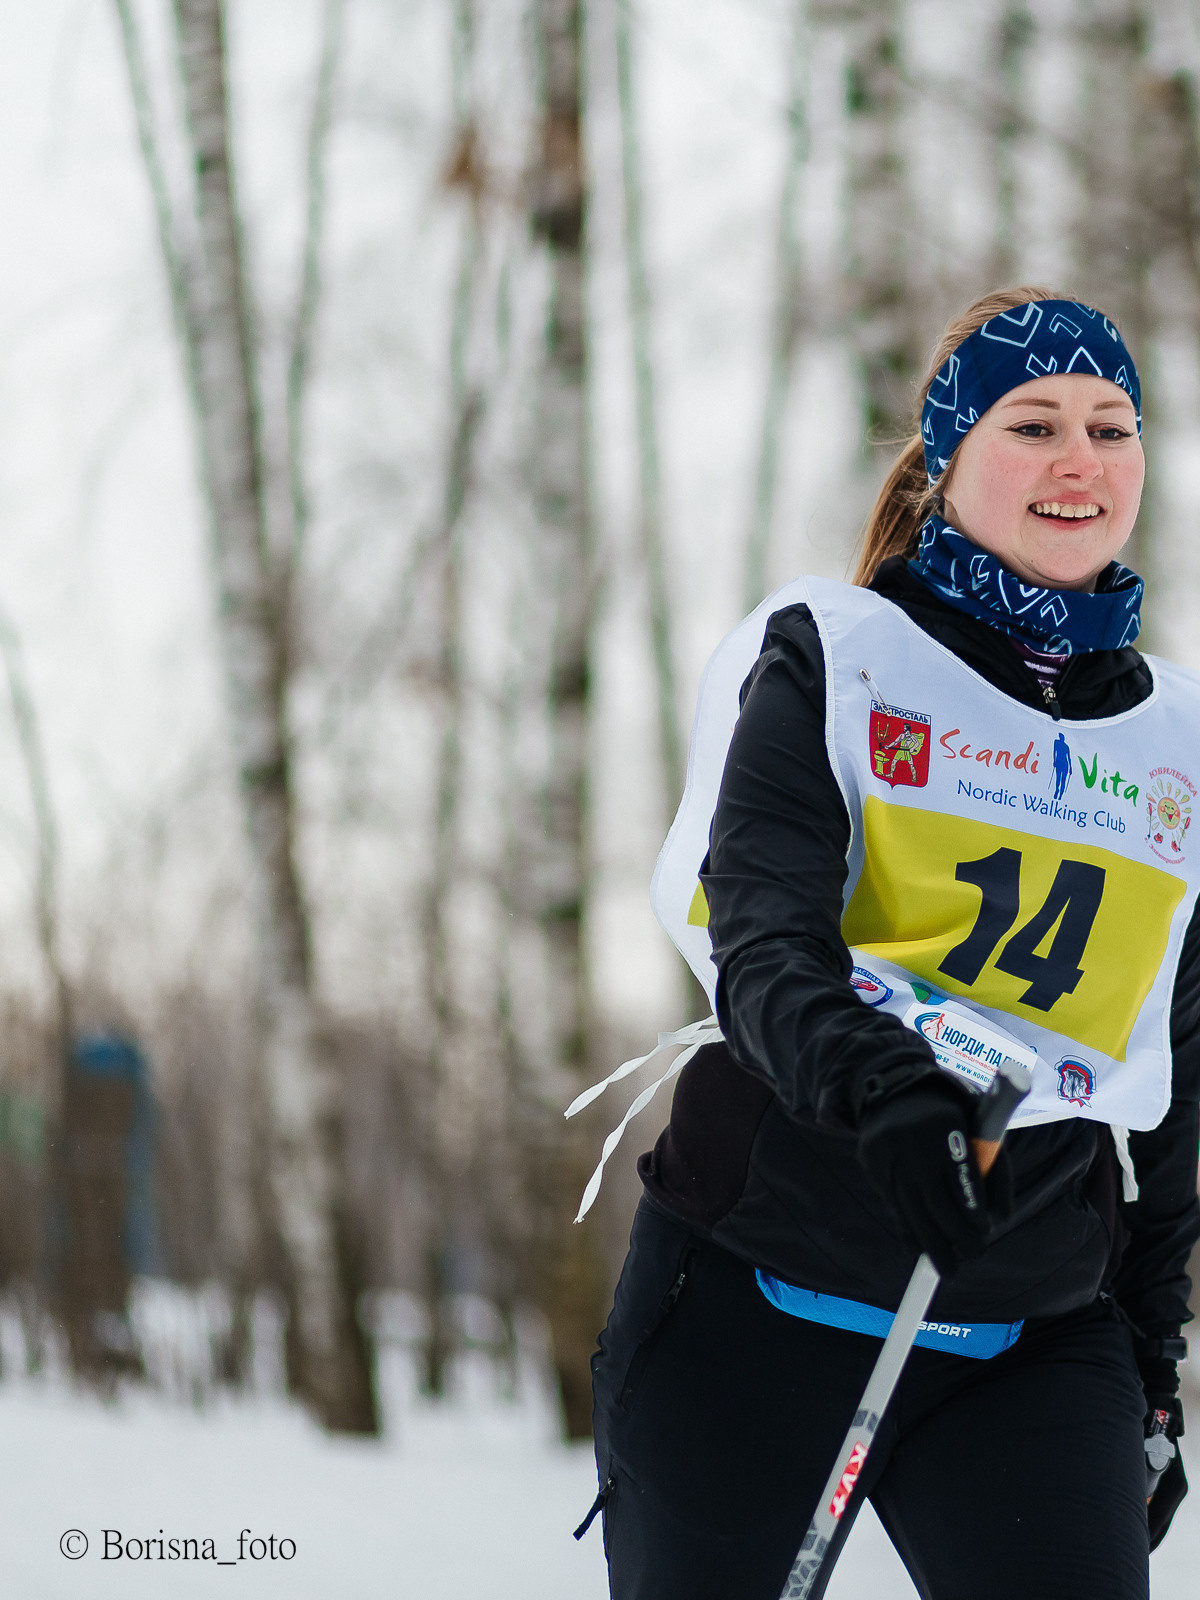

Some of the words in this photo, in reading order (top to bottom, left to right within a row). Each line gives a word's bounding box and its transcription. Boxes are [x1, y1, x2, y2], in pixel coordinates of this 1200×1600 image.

[939, 729, 1040, 774] Scandi
[1078, 753, 1139, 807] Vita
[1149, 767, 1197, 797] ЮБИЛЕЙКА
[957, 779, 1017, 808] Nordic
[1023, 794, 1087, 828] Walking
[1094, 811, 1126, 834] Club
[937, 846, 1106, 1012] 14
[853, 967, 880, 984] ЛАСТНАЯ
[941, 1026, 1028, 1069] НОРДИ-ПА
[918, 1321, 971, 1338] SPORT
